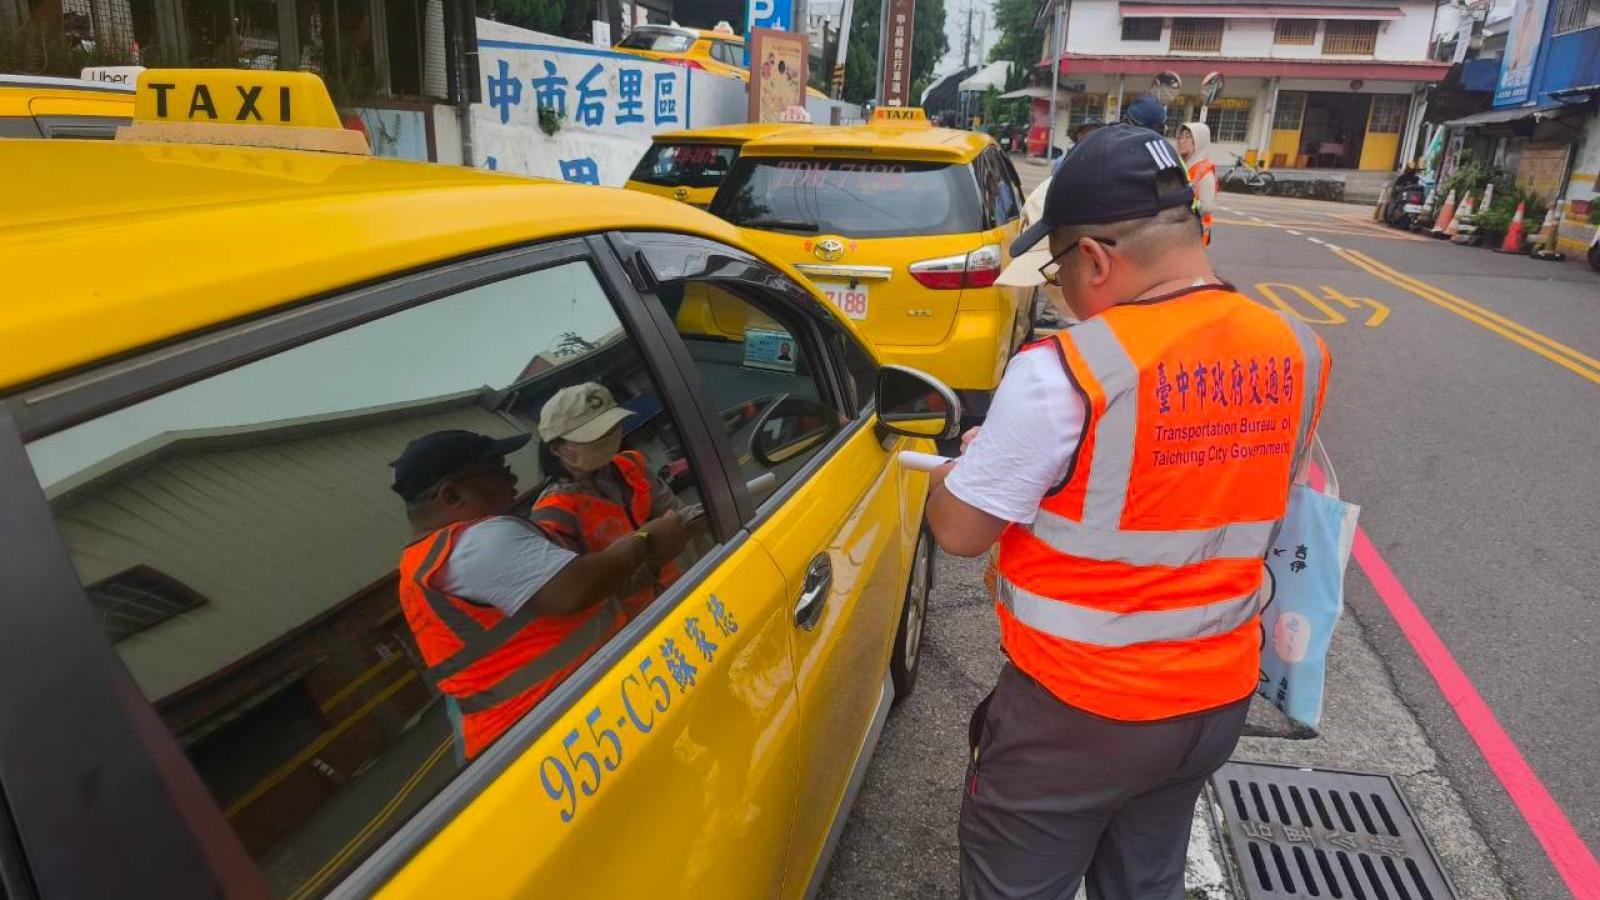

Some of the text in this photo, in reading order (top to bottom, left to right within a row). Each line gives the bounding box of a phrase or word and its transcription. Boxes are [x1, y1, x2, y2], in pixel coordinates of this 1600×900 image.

[748, 0, 775, 30] P
[91, 71, 128, 84] Uber
[147, 83, 291, 122] TAXI
[487, 59, 679, 127] 中市后里區
[884, 110, 915, 120] TAXI
[1156, 356, 1293, 414] 臺中市政府交通局
[1156, 422, 1237, 442] Transportation
[1239, 417, 1276, 433] Bureau
[1153, 440, 1290, 466] Taichung City Government
[539, 656, 671, 823] 955-C5
